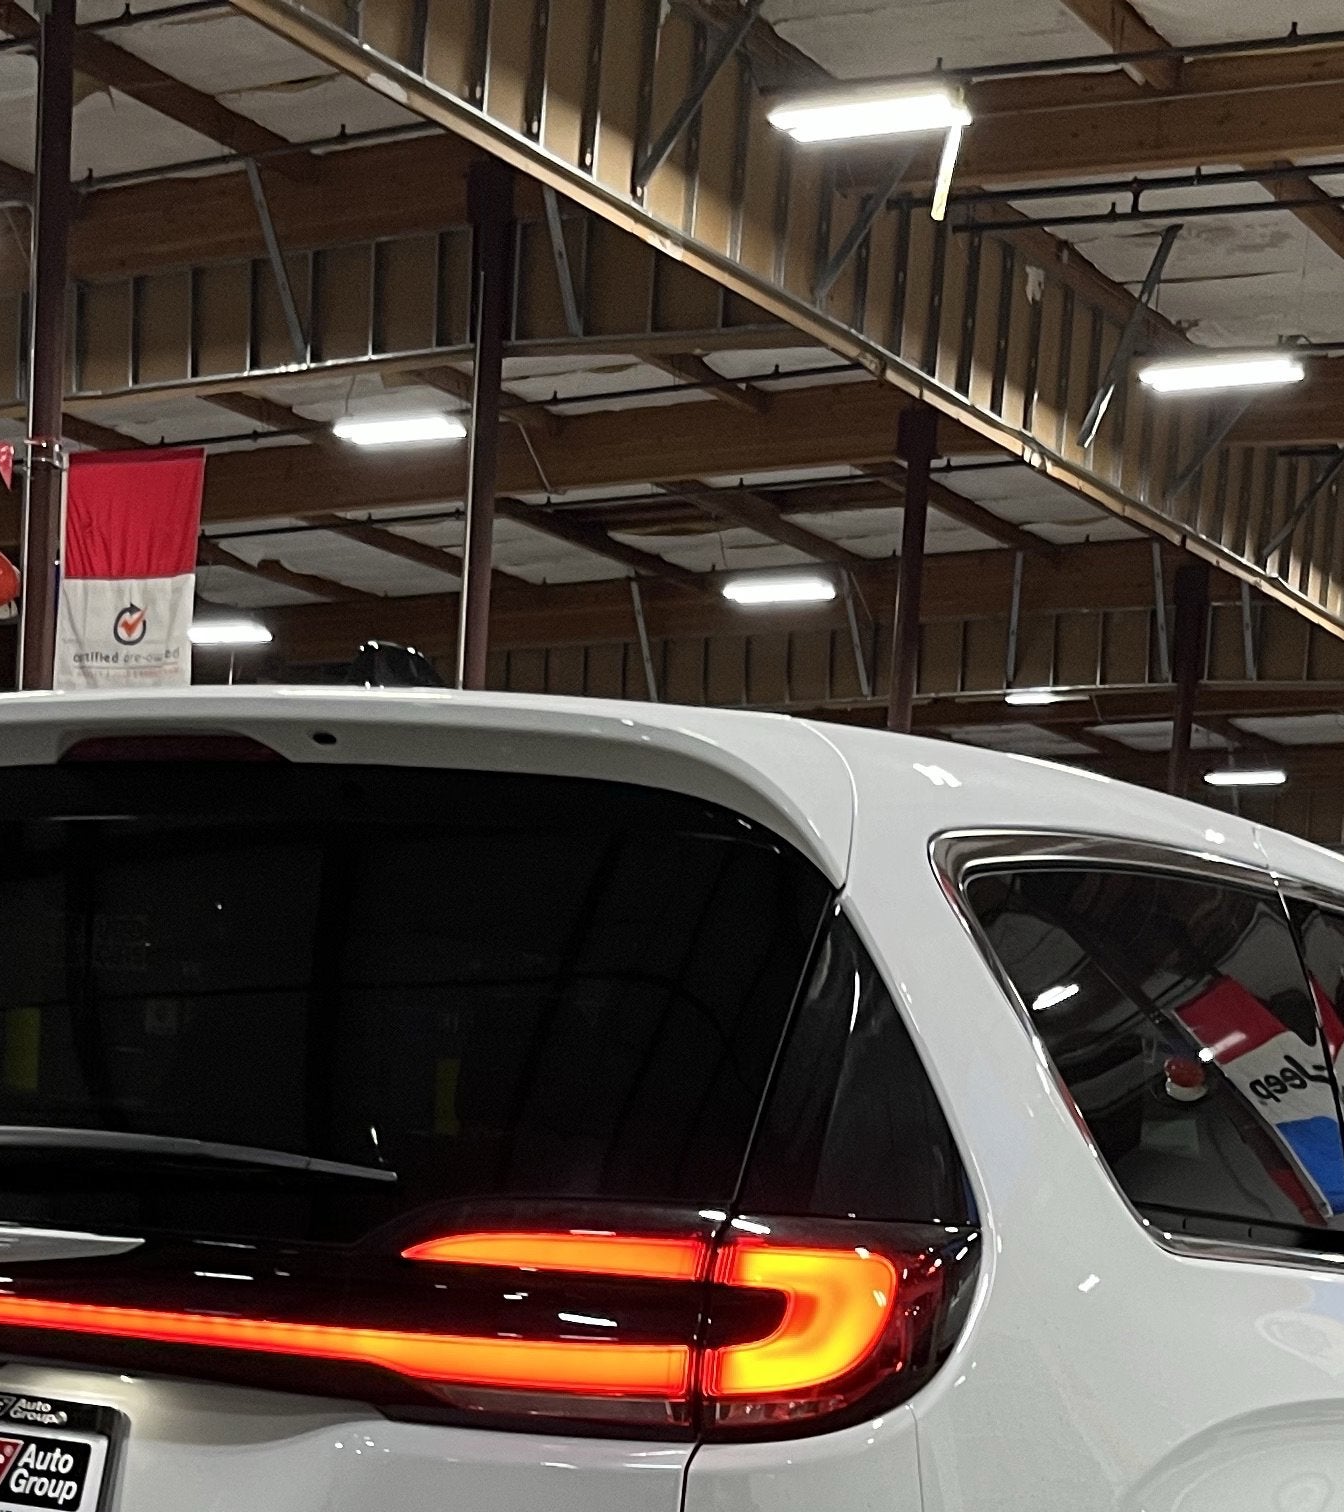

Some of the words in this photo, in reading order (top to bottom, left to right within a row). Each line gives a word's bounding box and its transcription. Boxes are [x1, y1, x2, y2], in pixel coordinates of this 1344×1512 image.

[14, 1398, 52, 1412] Auto
[9, 1409, 59, 1425] Group
[18, 1443, 74, 1474] Auto
[9, 1468, 78, 1504] Group
